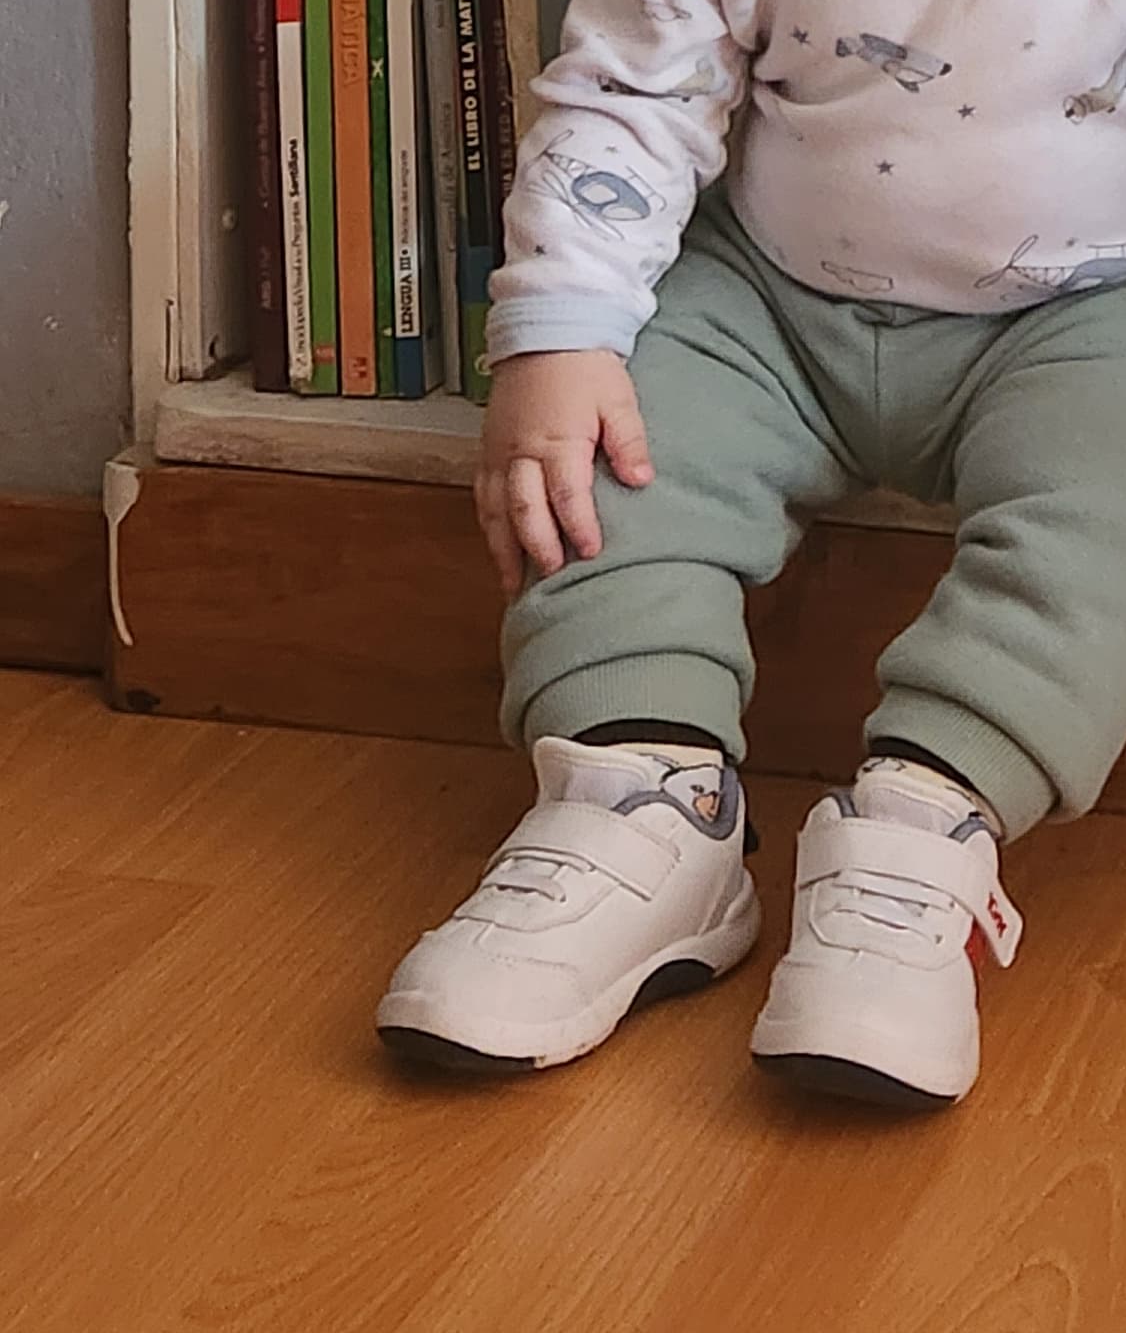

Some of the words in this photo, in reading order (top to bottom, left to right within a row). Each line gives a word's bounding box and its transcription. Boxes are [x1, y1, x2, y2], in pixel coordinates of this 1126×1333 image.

[461, 41, 476, 63] LA
[462, 68, 477, 91] DE
[464, 96, 480, 147] LIBRO
[467, 151, 481, 171] EL
[399, 256, 412, 271] III
[400, 273, 414, 334] LENGUA
